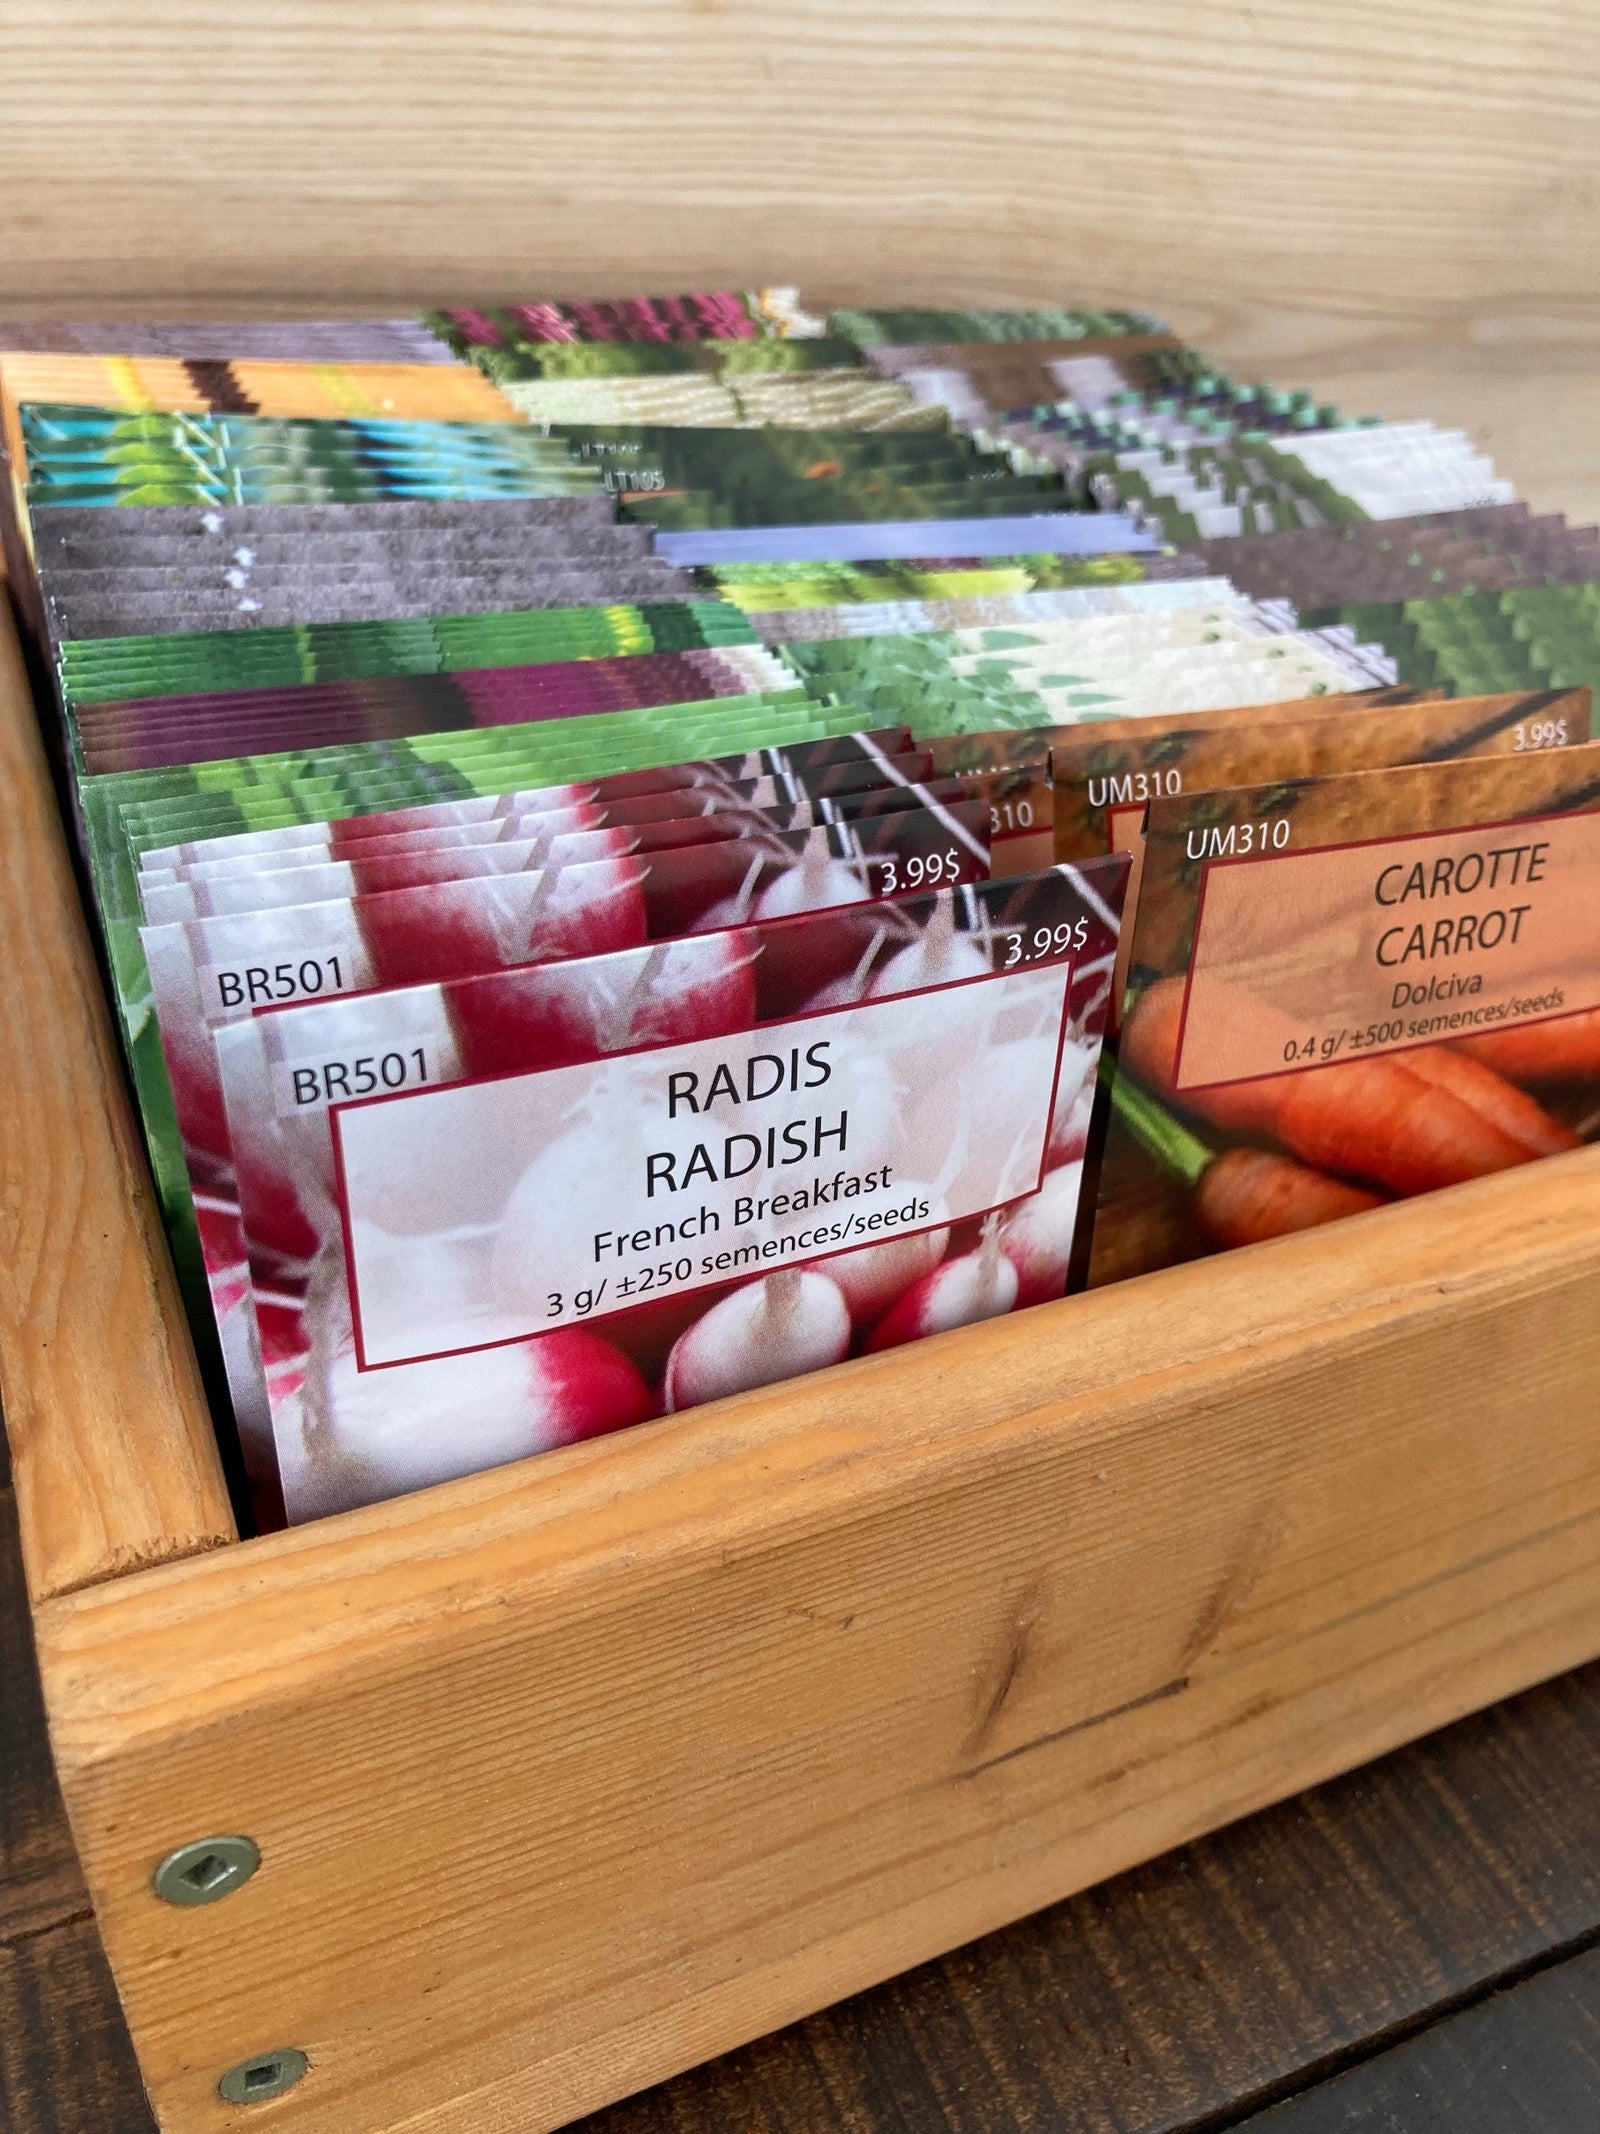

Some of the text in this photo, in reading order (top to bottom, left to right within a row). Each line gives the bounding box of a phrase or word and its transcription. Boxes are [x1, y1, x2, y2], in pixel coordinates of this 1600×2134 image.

[603, 470, 665, 491] LT105
[1512, 719, 1568, 751] 3.99$
[1088, 769, 1182, 807] UM310
[990, 801, 1034, 833] 310
[1186, 820, 1290, 859] UM310
[880, 848, 961, 893] 3.99$
[1374, 843, 1549, 906] CAROTTE
[1004, 916, 1088, 965] 3.99$
[1376, 905, 1531, 967] CARROT
[218, 956, 343, 1007] BR501
[1391, 973, 1482, 1009] Dolciva
[1283, 987, 1565, 1062] 0.4 g/ ±500 semences/seeds
[293, 1048, 427, 1105] BR501
[668, 1041, 832, 1118] RADIS
[646, 1110, 848, 1198] RADISH
[593, 1165, 893, 1263] French Breakfast
[546, 1198, 930, 1317] 3 g/ ±250 semences/seeds
